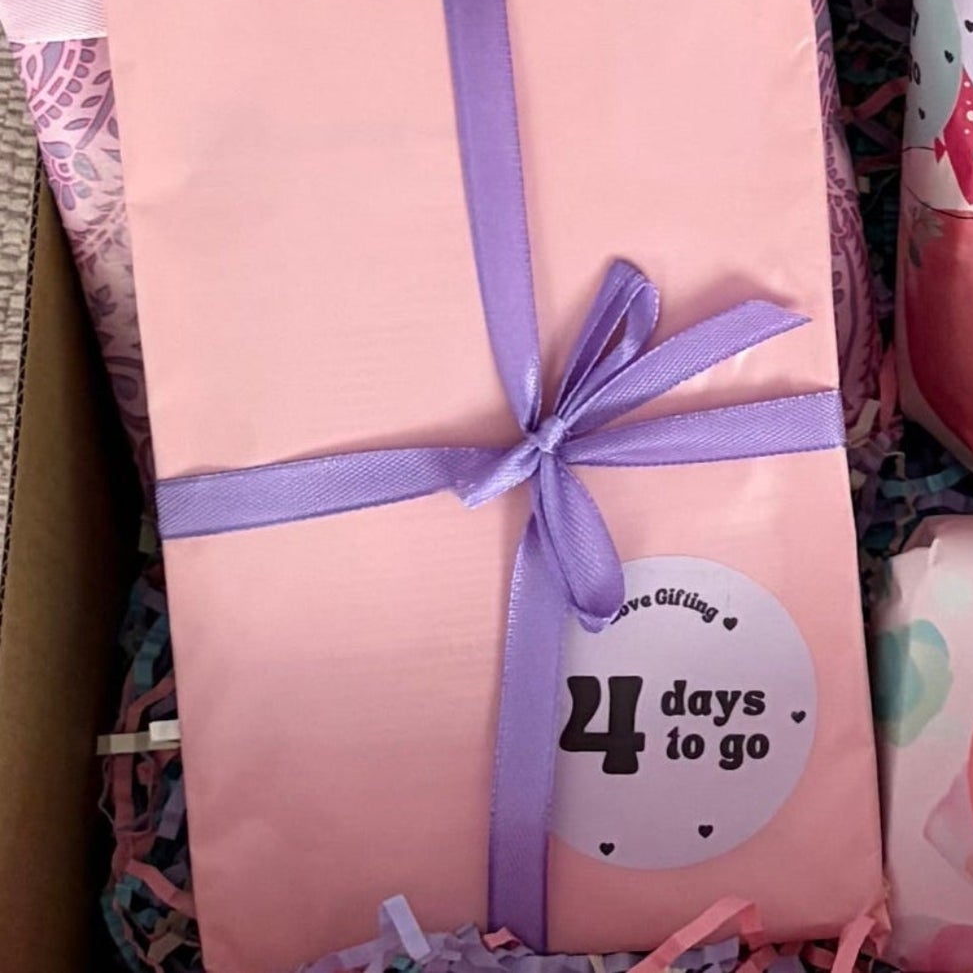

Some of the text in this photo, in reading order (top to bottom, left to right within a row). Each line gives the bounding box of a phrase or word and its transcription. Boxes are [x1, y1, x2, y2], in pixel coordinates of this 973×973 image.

[655, 589, 718, 623] Gifting
[559, 676, 645, 774] 4
[661, 680, 765, 727] days
[667, 727, 769, 770] to go
